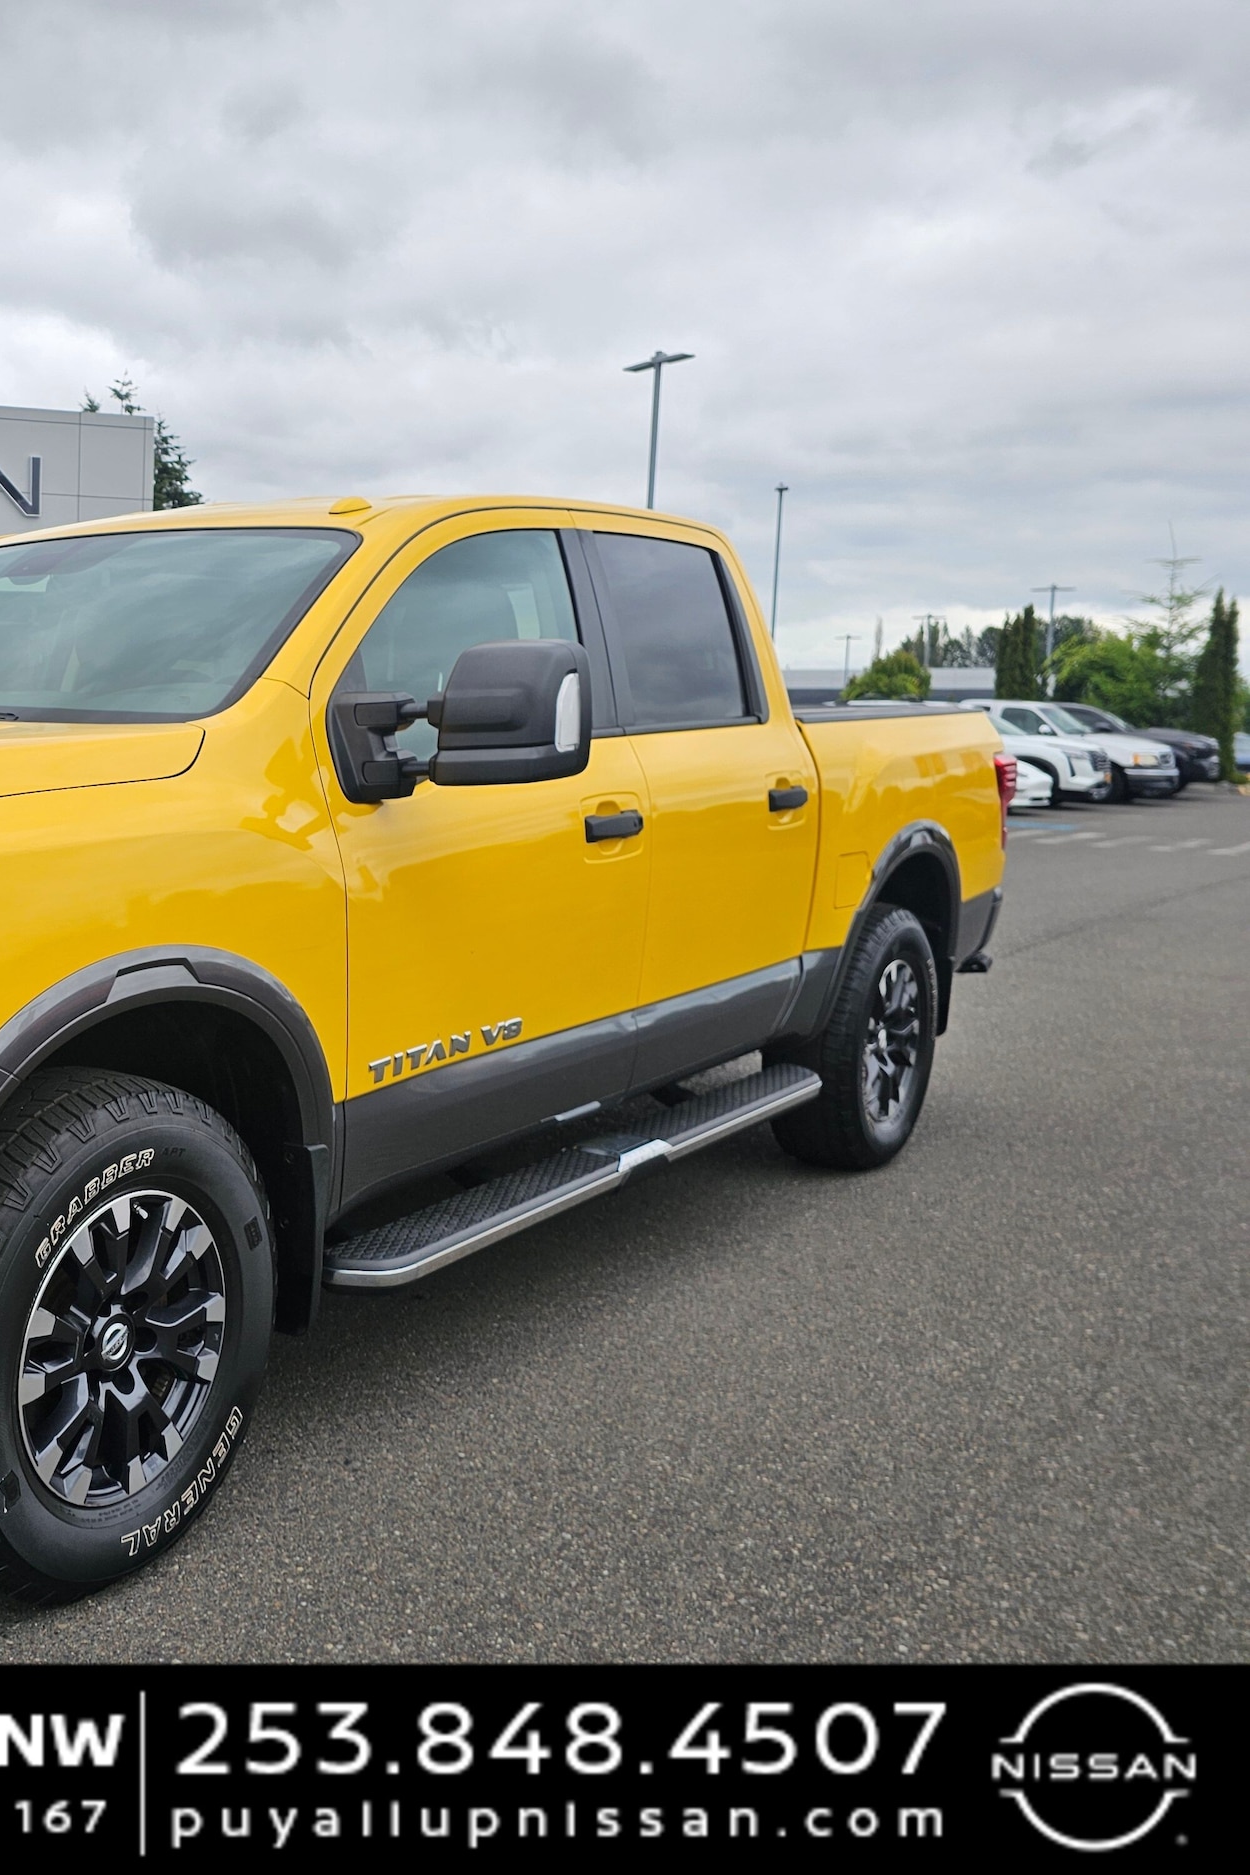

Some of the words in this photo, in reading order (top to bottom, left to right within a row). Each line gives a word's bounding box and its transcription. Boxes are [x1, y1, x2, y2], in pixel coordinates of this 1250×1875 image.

[368, 1031, 471, 1084] TITAN
[481, 1017, 523, 1046] V8
[35, 1148, 155, 1268] GRABBER
[121, 1405, 243, 1557] GENERAL
